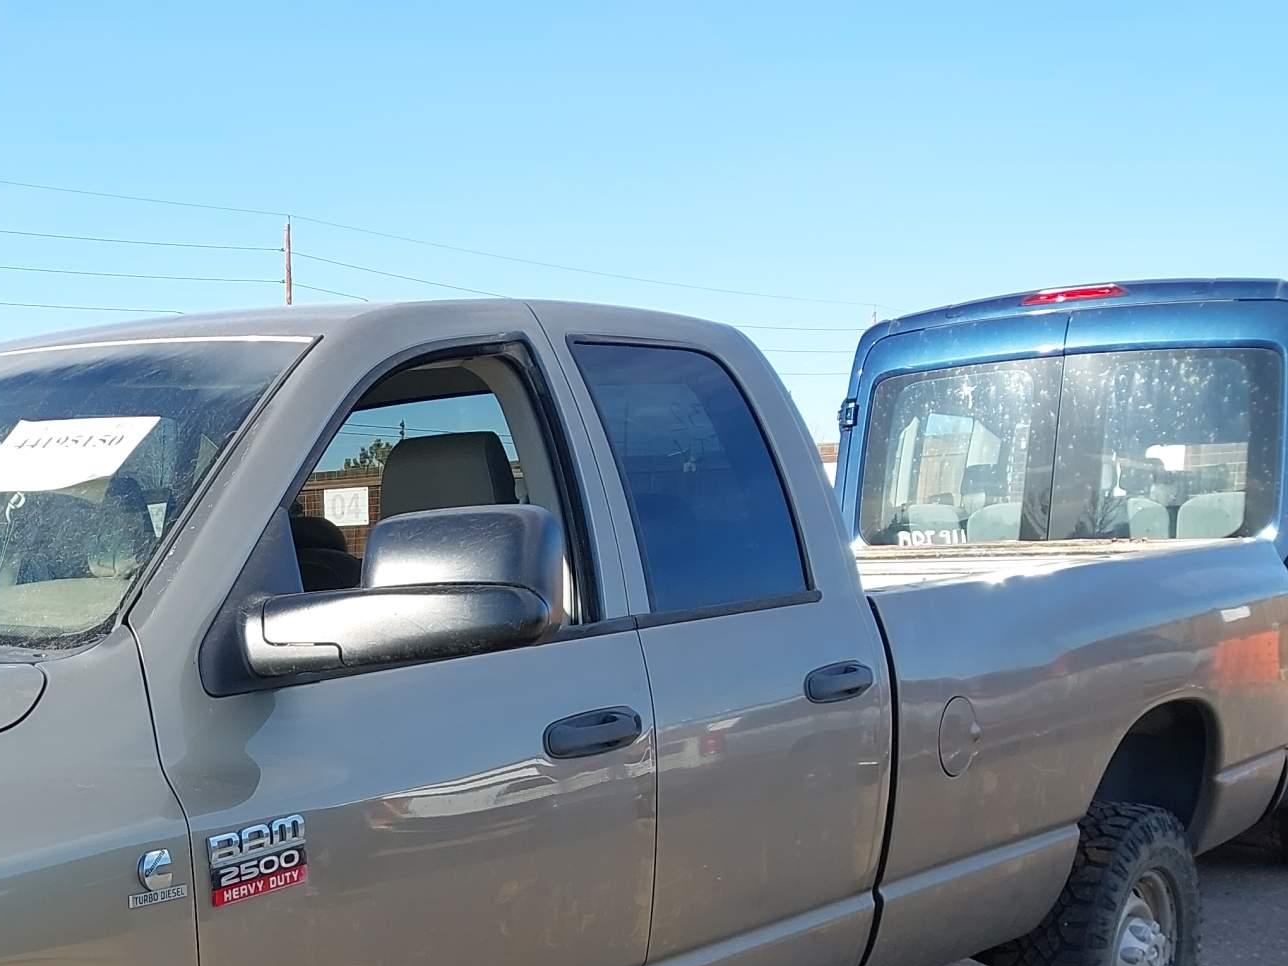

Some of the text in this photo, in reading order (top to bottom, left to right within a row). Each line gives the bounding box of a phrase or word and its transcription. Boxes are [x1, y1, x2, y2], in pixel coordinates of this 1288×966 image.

[14, 433, 124, 449] 44195150
[331, 492, 362, 520] 04
[208, 814, 306, 863] RAM
[219, 849, 300, 887] 2500
[135, 887, 185, 906] TURBO DIESEL
[223, 869, 299, 902] HEAVY DUTY
